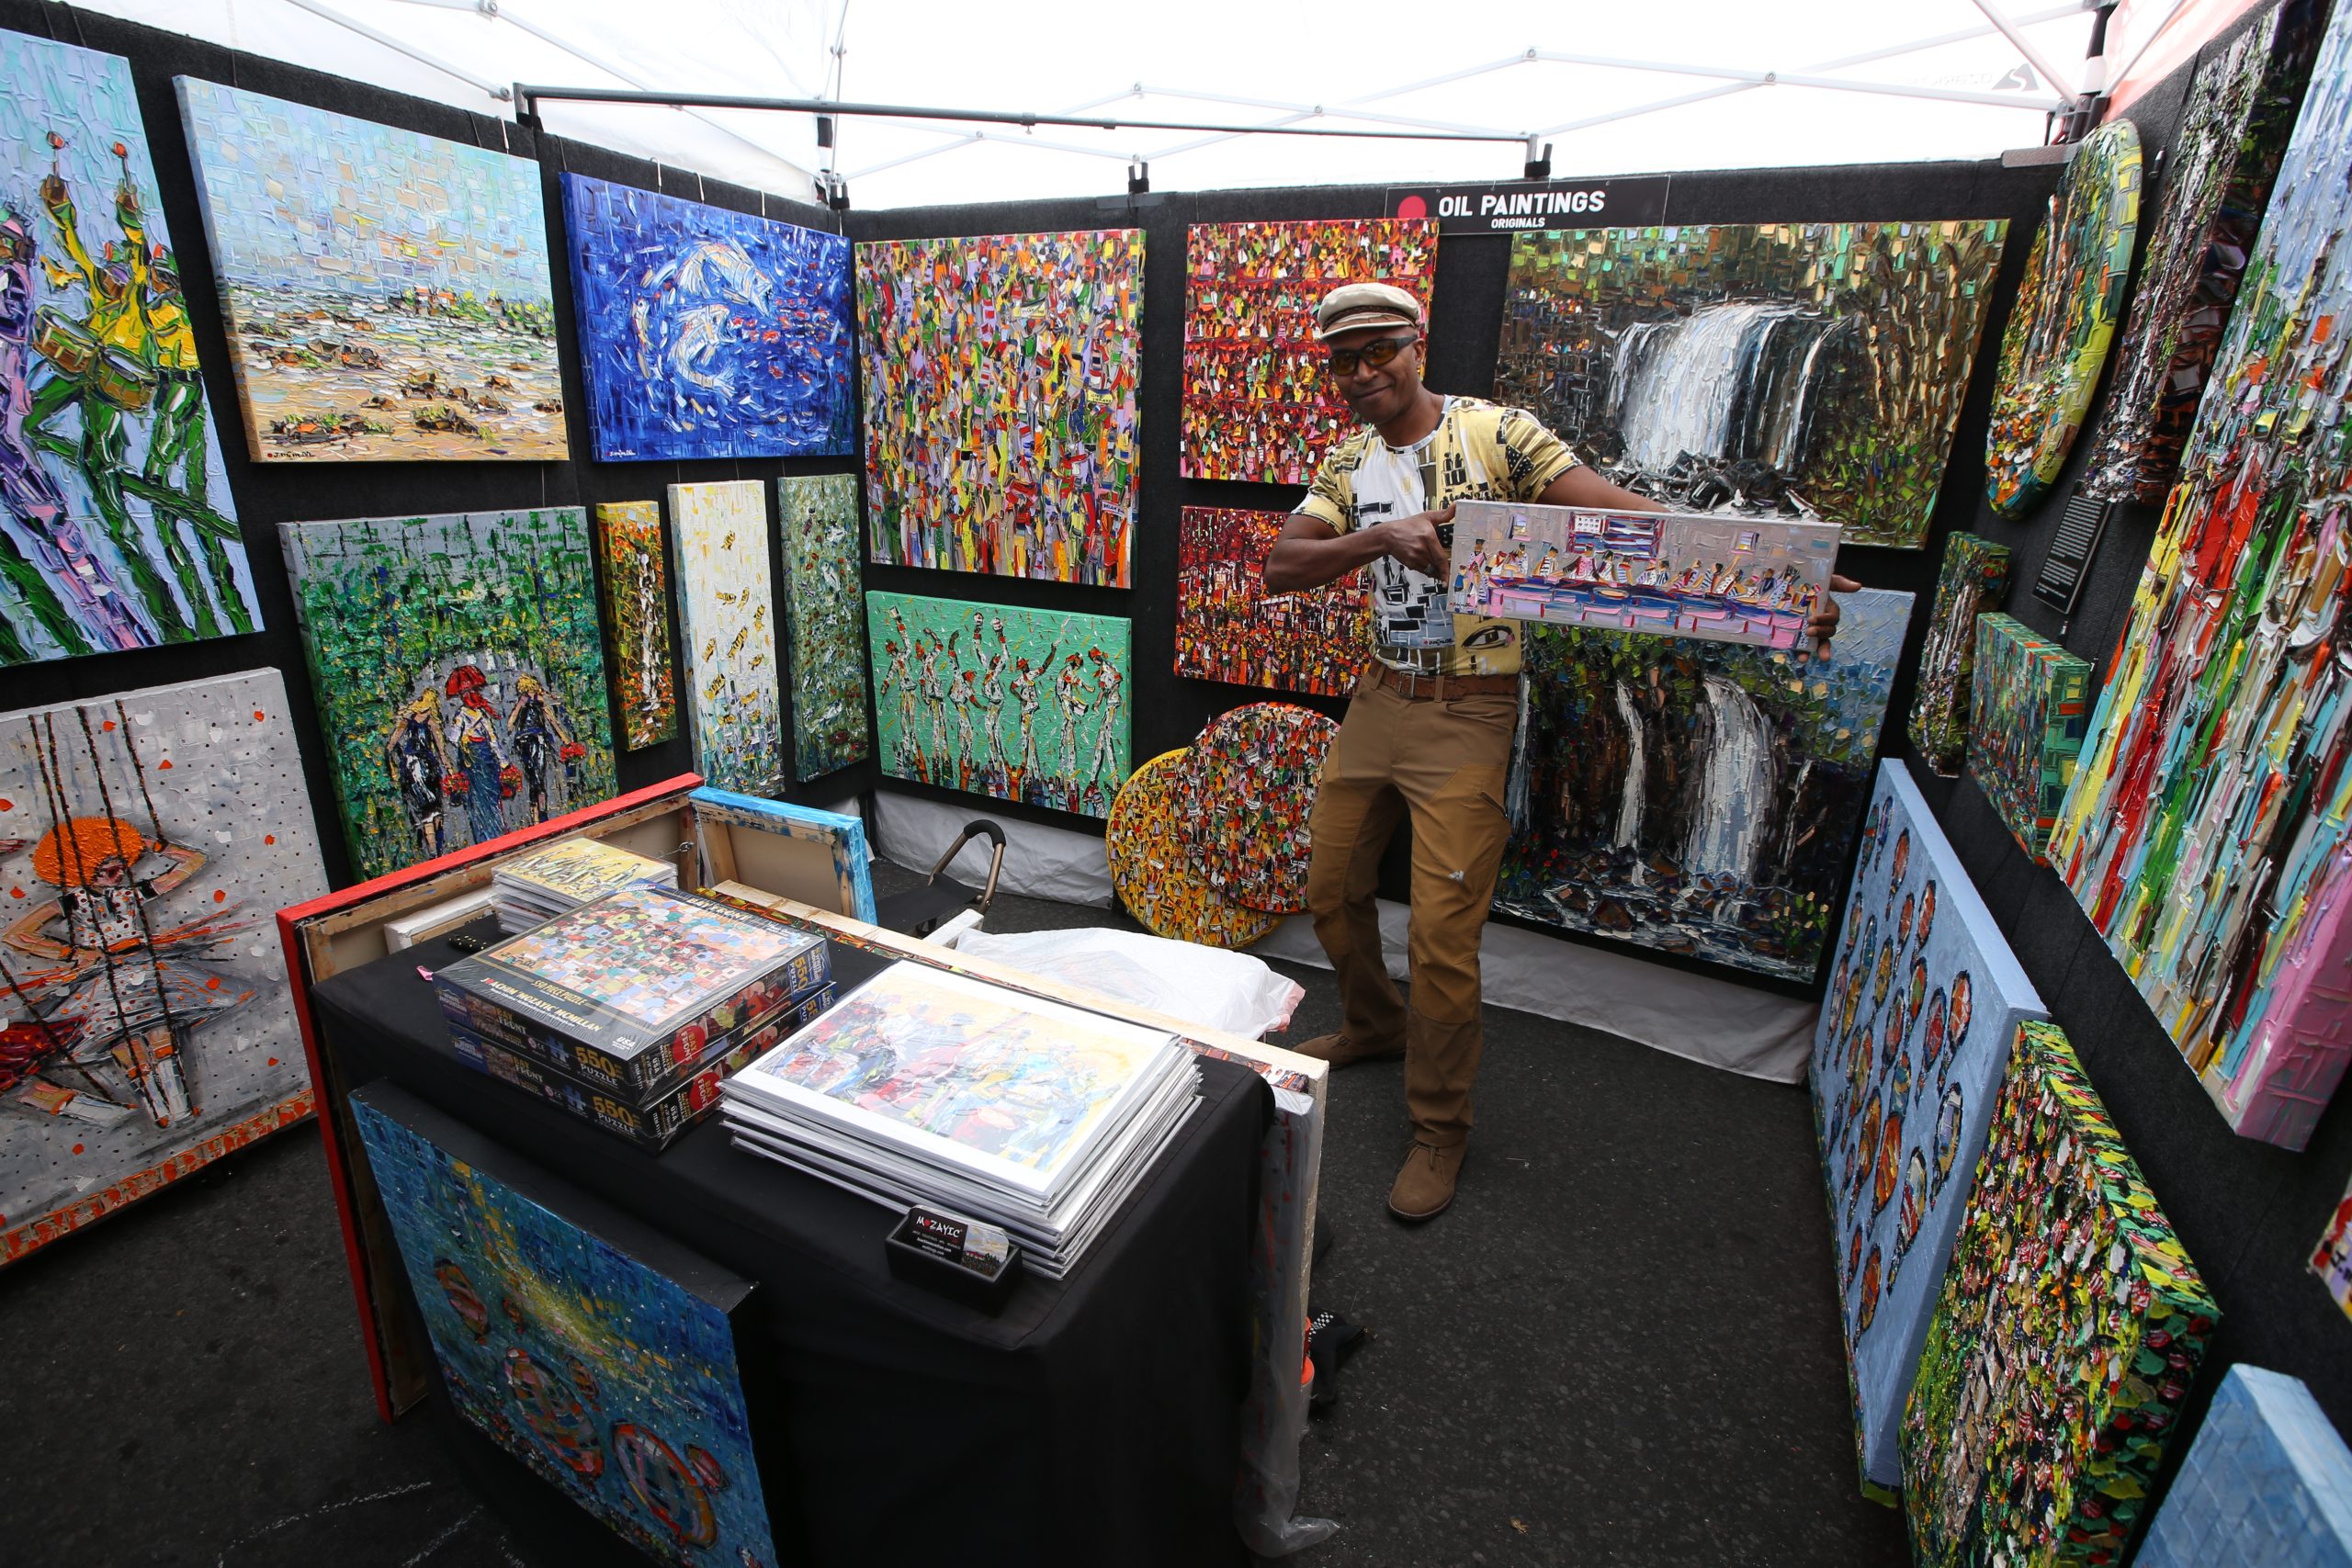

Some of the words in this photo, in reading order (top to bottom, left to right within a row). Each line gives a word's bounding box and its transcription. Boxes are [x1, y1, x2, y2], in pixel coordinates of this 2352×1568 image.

[1438, 196, 1473, 217] OIL
[1480, 190, 1605, 216] PAINTINGS
[1490, 217, 1545, 229] ORIGINALS
[794, 957, 808, 990] 550
[560, 990, 588, 1006] PUZZLE
[499, 1017, 526, 1035] FRONT
[616, 1037, 636, 1048] USA
[681, 1031, 693, 1062] FRONT
[688, 1032, 697, 1052] BAY
[575, 1046, 616, 1077] 550
[652, 1057, 661, 1074] USA
[515, 1065, 543, 1084] FRONT
[580, 1064, 617, 1087] PUZZLE
[697, 1078, 708, 1107] FRONT
[705, 1080, 714, 1098] BAY
[593, 1096, 634, 1128] 550
[597, 1112, 637, 1135] PUZZLE
